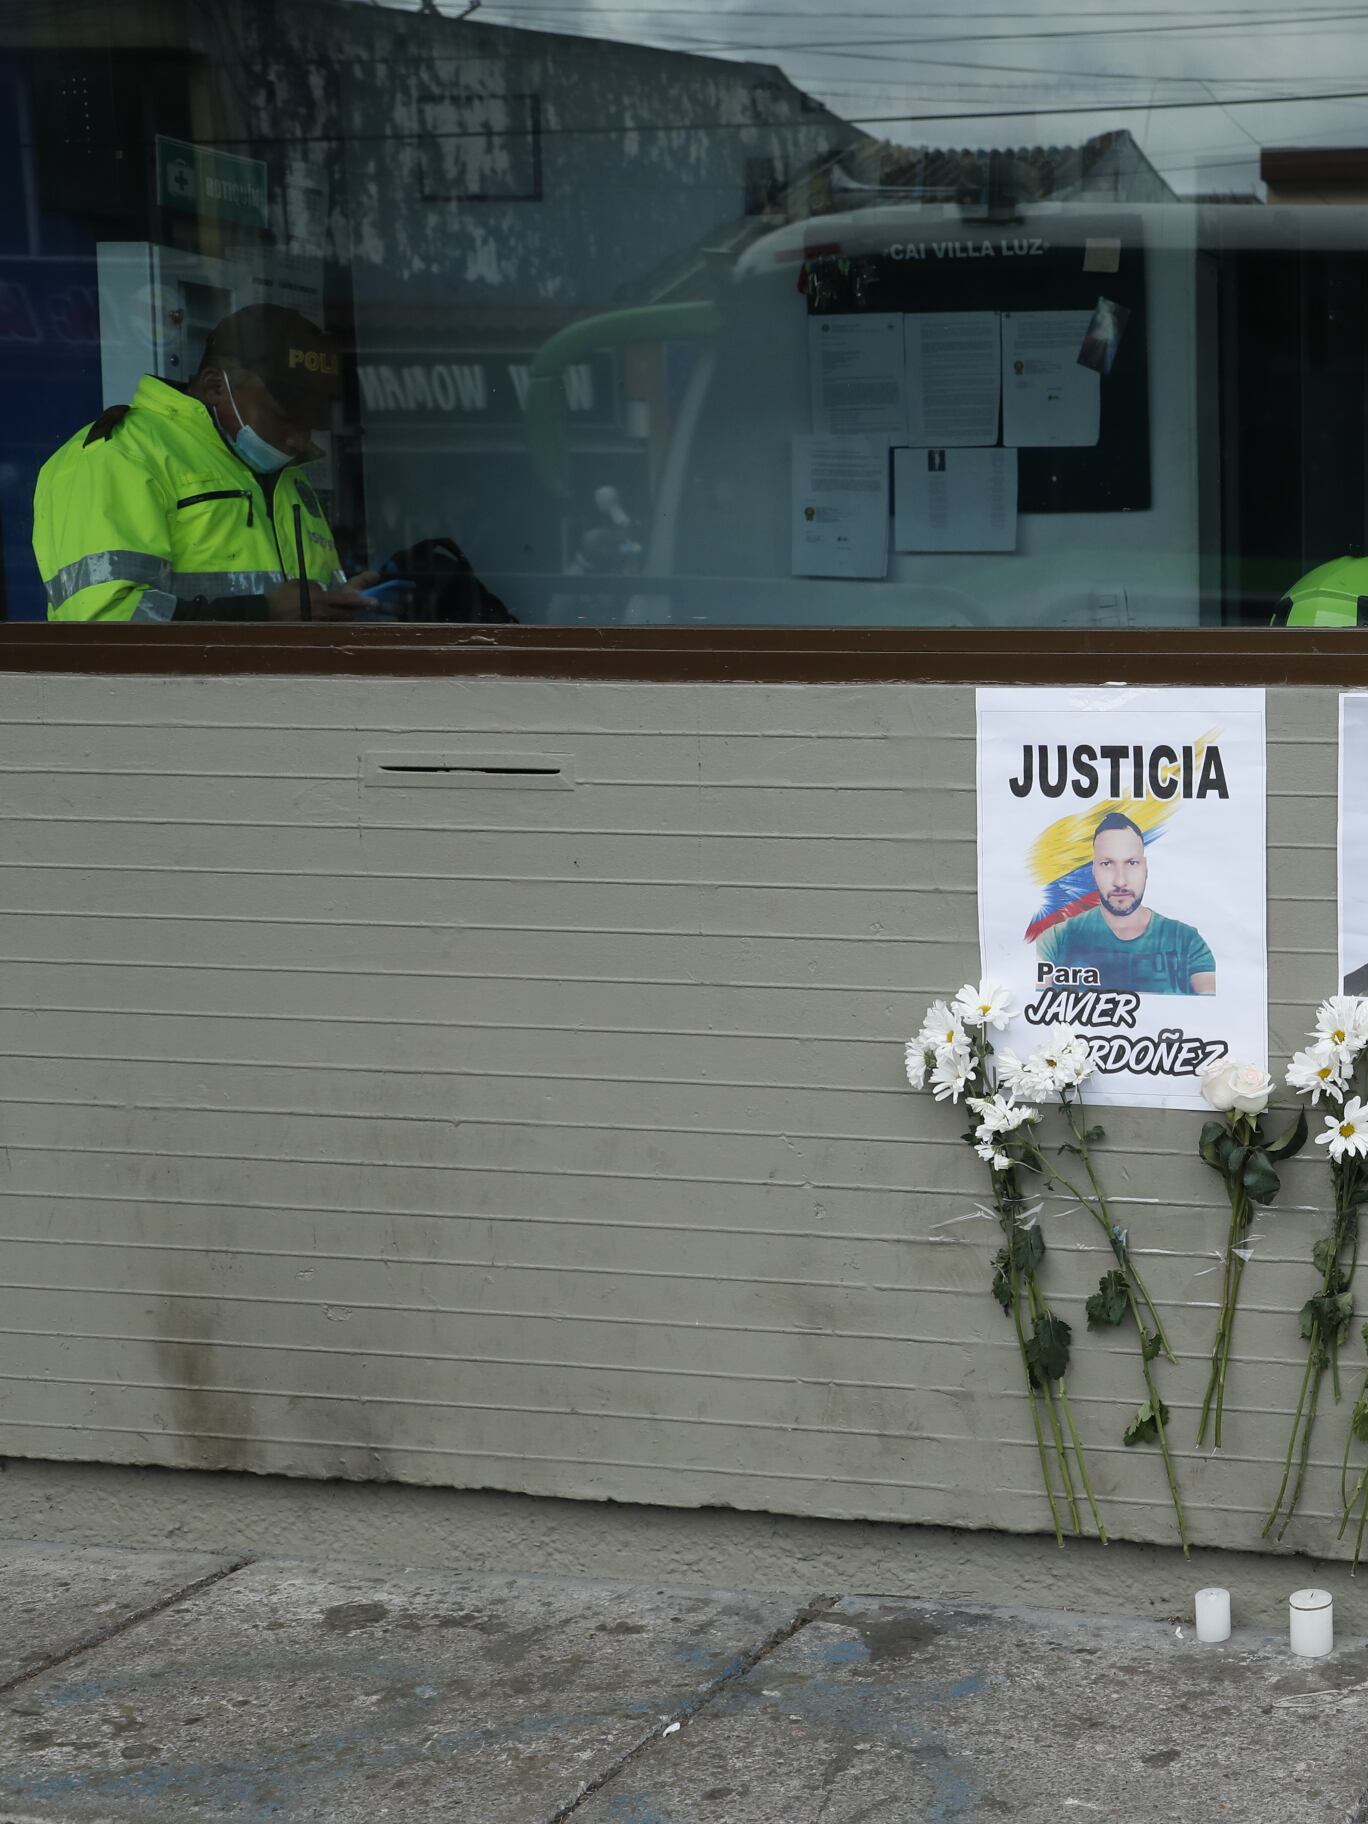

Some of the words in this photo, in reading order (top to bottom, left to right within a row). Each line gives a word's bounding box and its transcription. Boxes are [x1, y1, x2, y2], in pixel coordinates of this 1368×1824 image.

[889, 243, 927, 260] CAI
[932, 239, 995, 259] VILLA
[1001, 238, 1043, 257] LUZ
[1008, 744, 1230, 799] JUSTICIA
[1037, 962, 1099, 985] Para
[1025, 988, 1140, 1029] JAVIER
